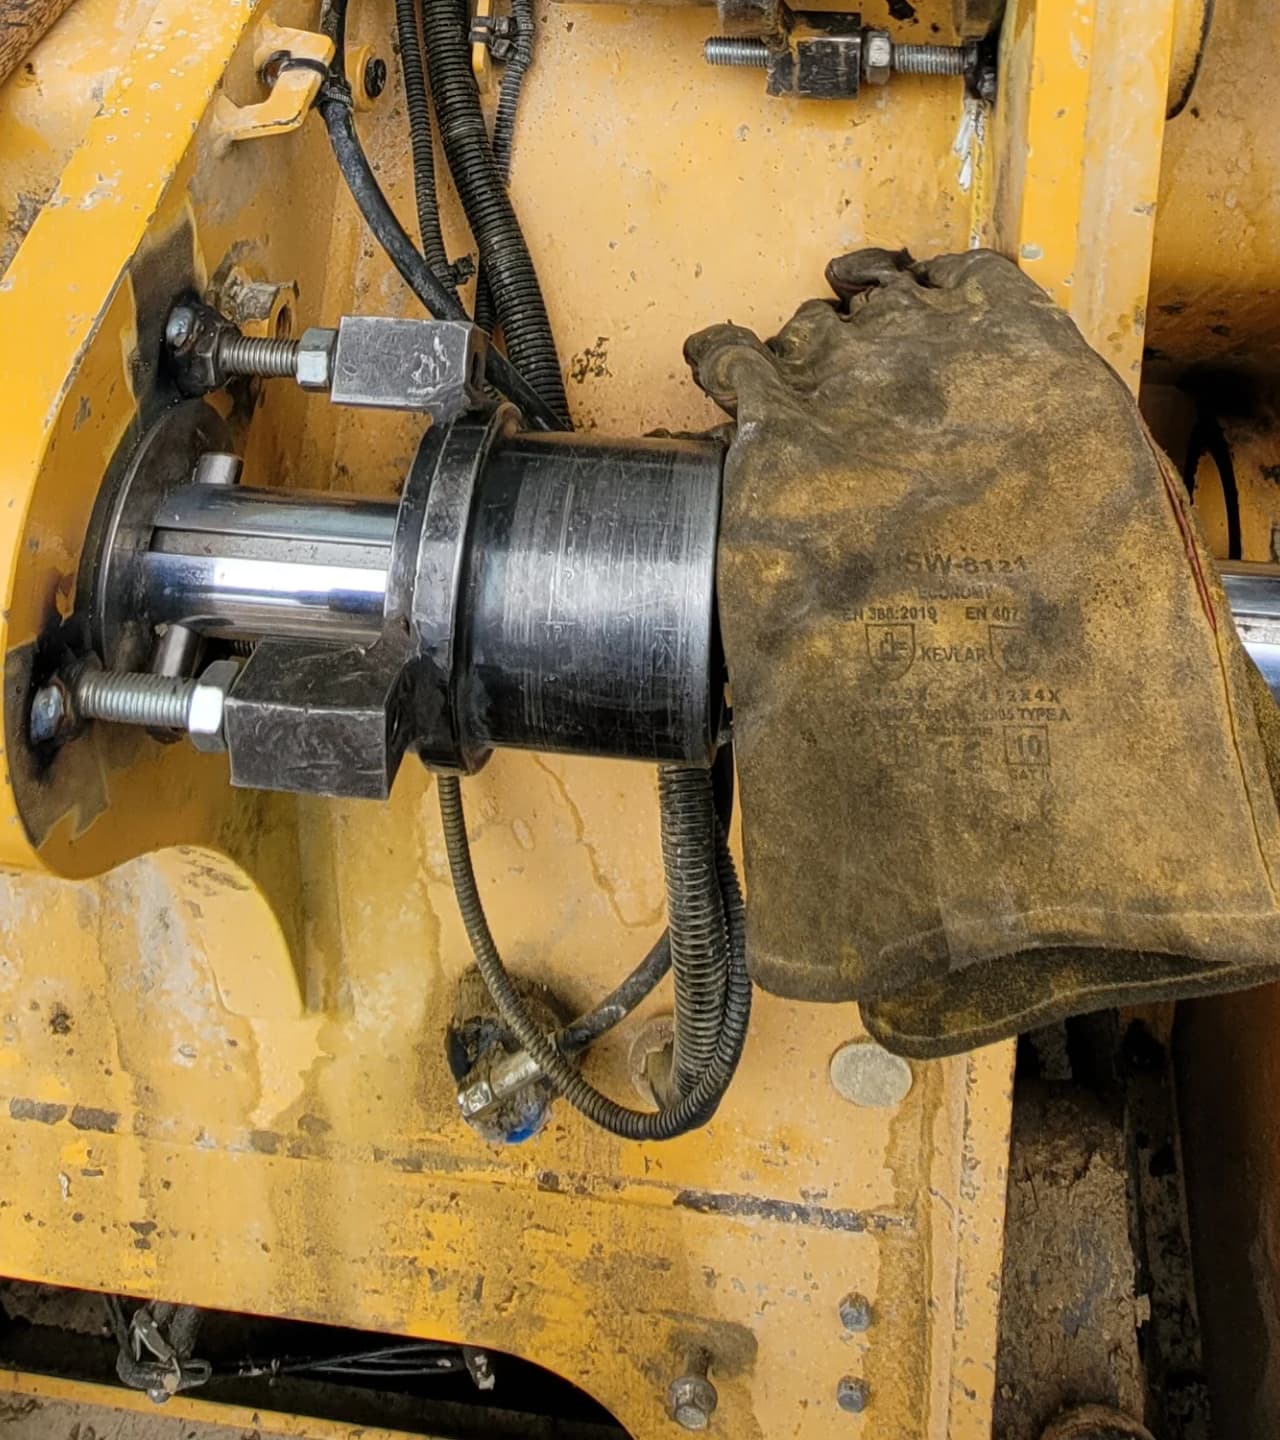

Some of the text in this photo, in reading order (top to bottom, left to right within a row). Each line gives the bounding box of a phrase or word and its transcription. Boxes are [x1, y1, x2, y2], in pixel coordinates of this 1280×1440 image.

[965, 606, 987, 620] EN
[921, 646, 987, 662] KEVLAR
[1019, 708, 1056, 722] TYPE
[1059, 709, 1072, 722] A
[1015, 734, 1043, 758] 10
